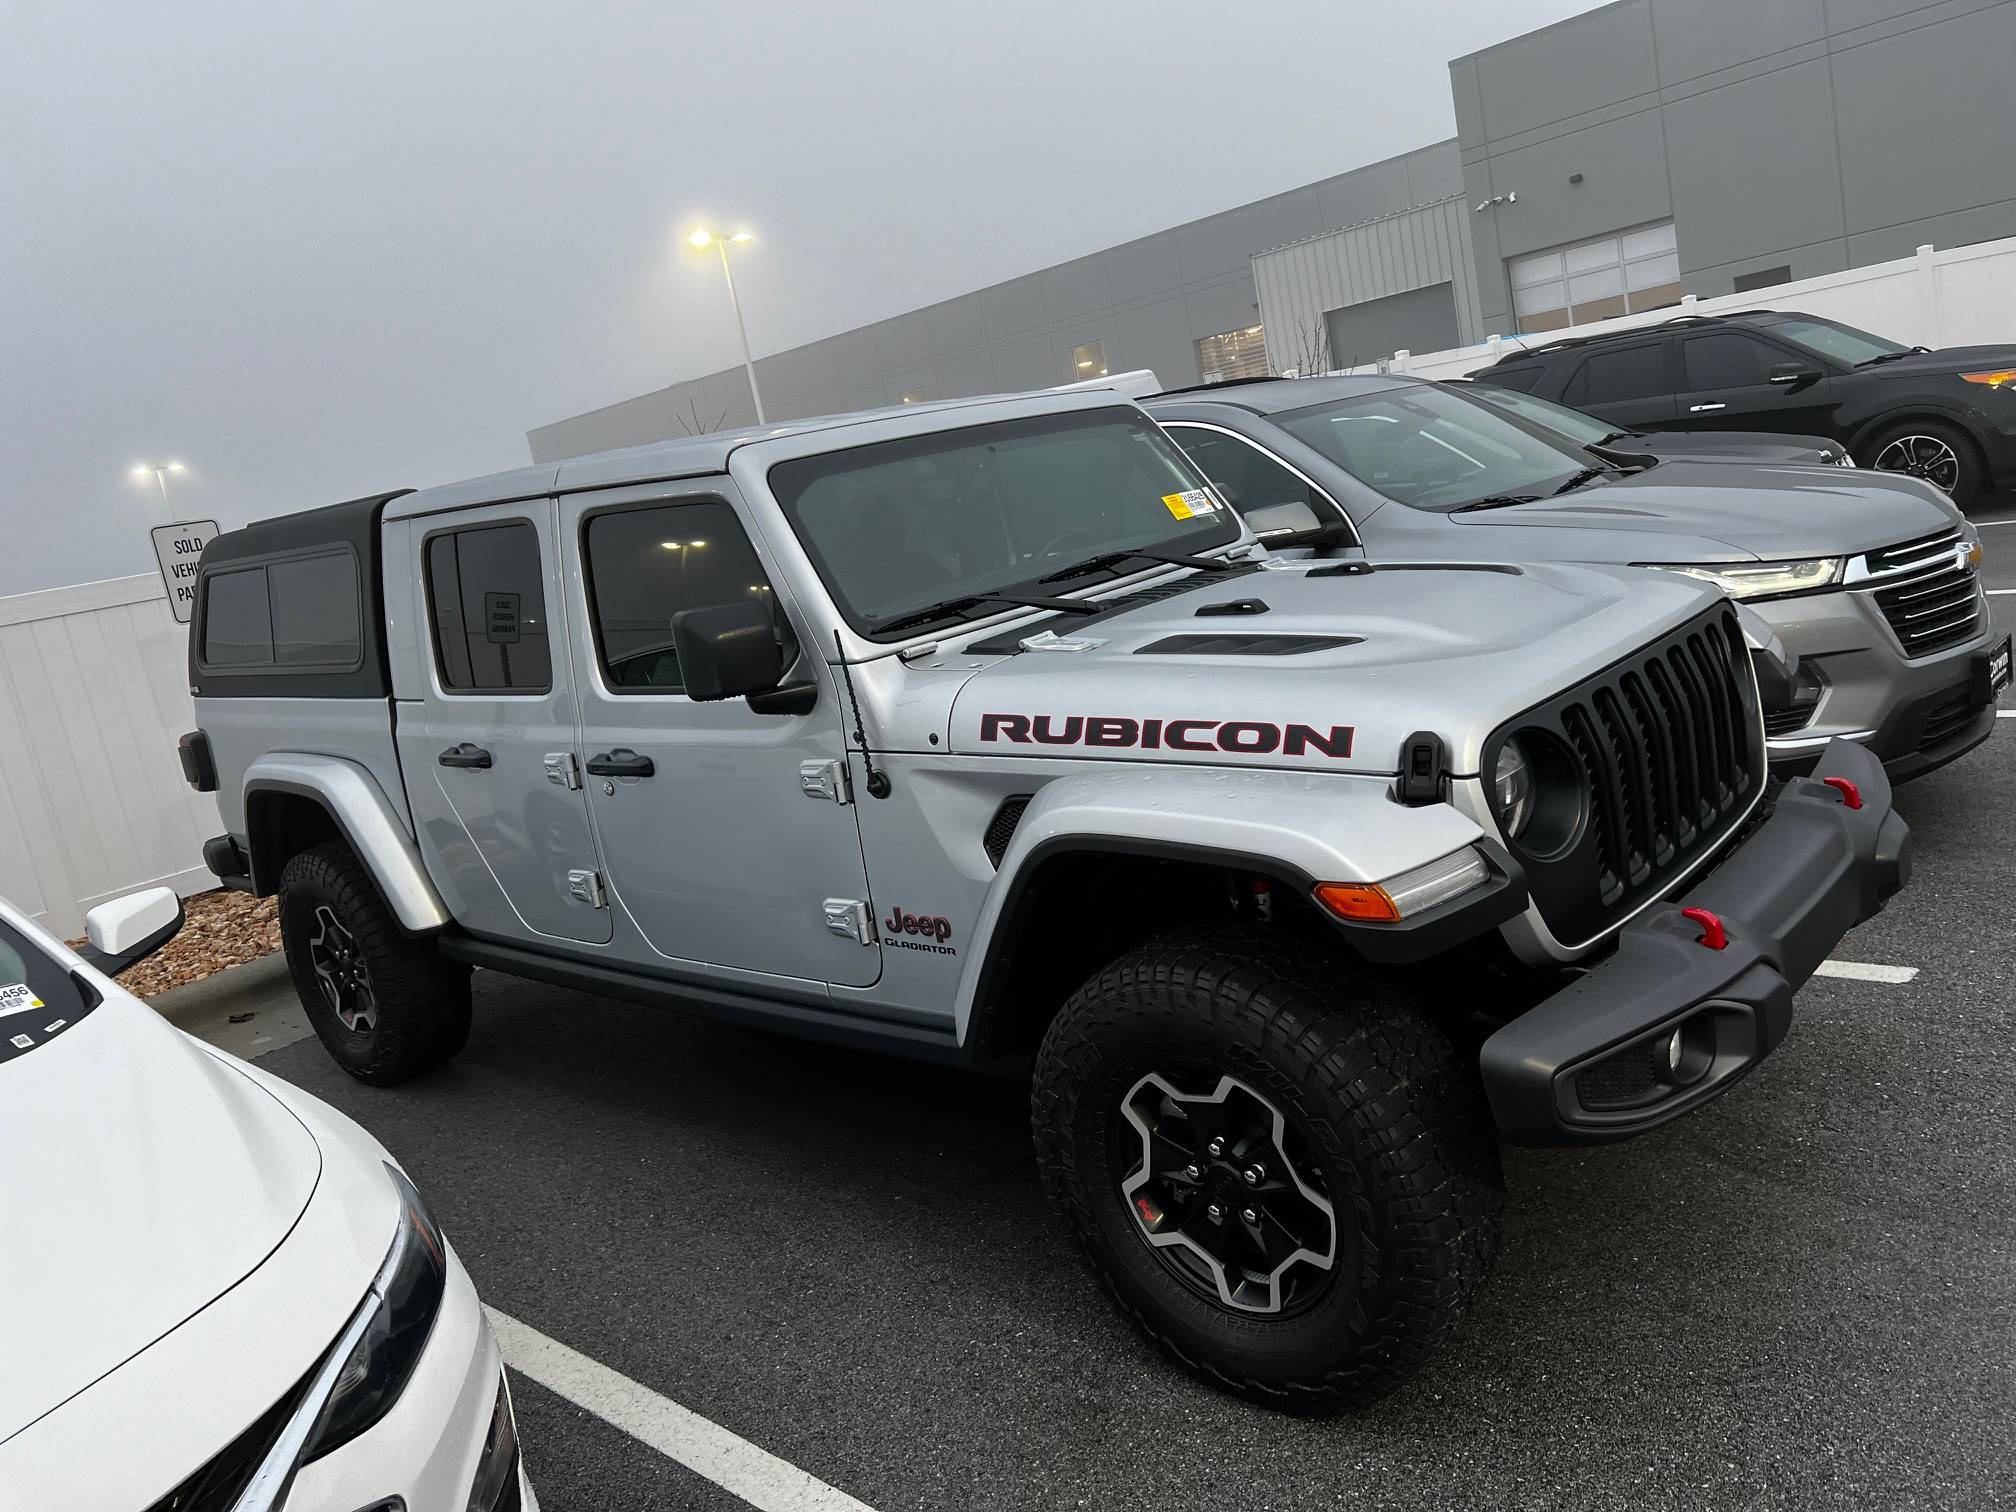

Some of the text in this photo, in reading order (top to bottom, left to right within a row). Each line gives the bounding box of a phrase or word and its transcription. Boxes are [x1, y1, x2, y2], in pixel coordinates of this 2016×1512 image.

[174, 537, 203, 555] SOLD
[979, 713, 1355, 759] RUBICON
[885, 905, 952, 943] Jeep
[884, 937, 957, 956] GLADIATOR
